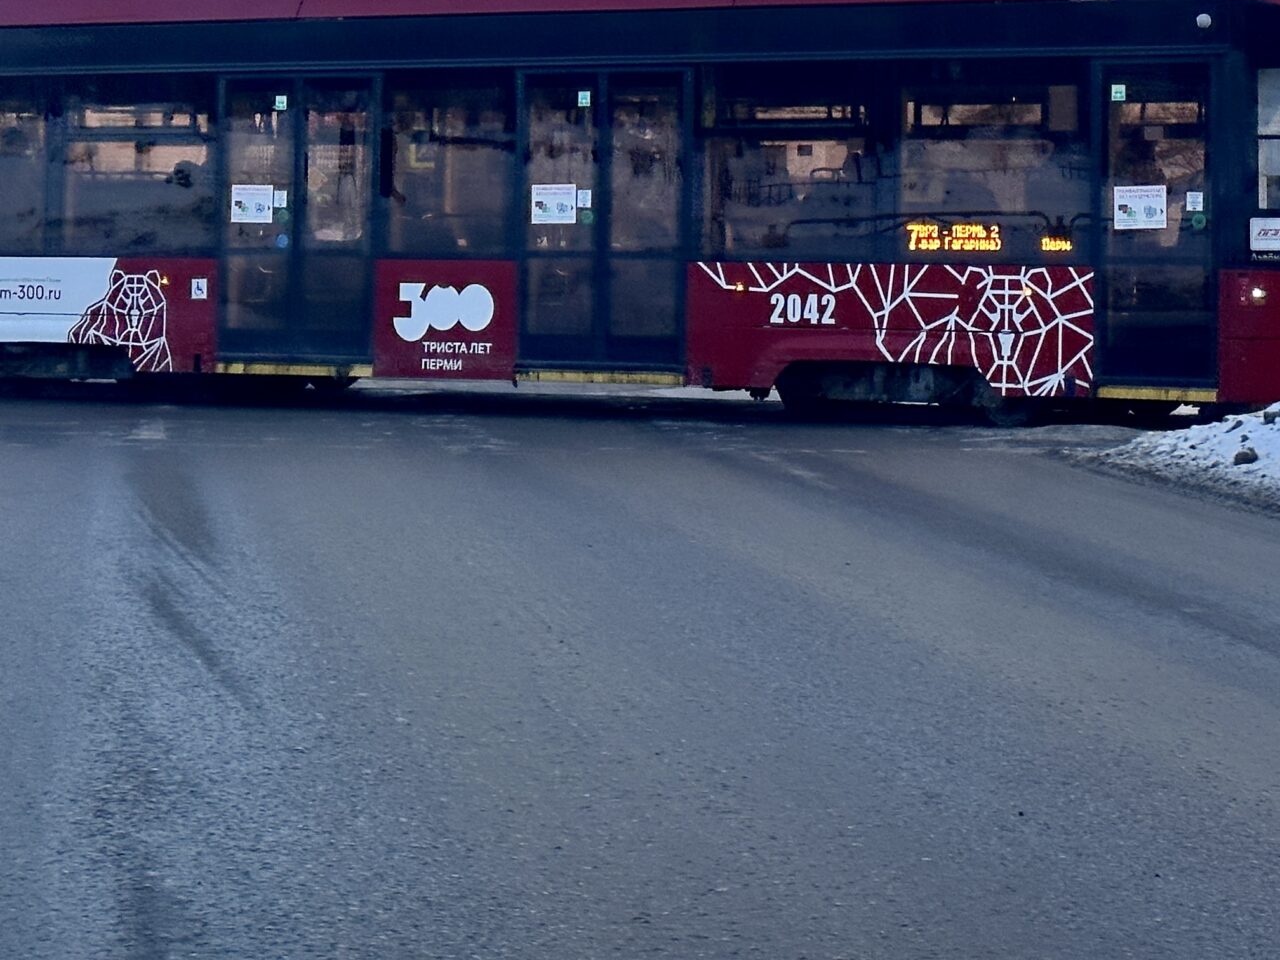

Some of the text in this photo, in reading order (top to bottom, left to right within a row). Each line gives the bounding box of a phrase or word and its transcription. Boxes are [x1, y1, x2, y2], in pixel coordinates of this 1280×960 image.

[906, 224, 919, 251] 7
[952, 224, 987, 238] ПЕРМЬ
[990, 225, 999, 238] 2
[393, 283, 495, 342] 300
[770, 293, 836, 325] 2042
[422, 342, 493, 355] ТРИСТА ЛЕТ
[421, 358, 463, 371] ПЕРМИ
